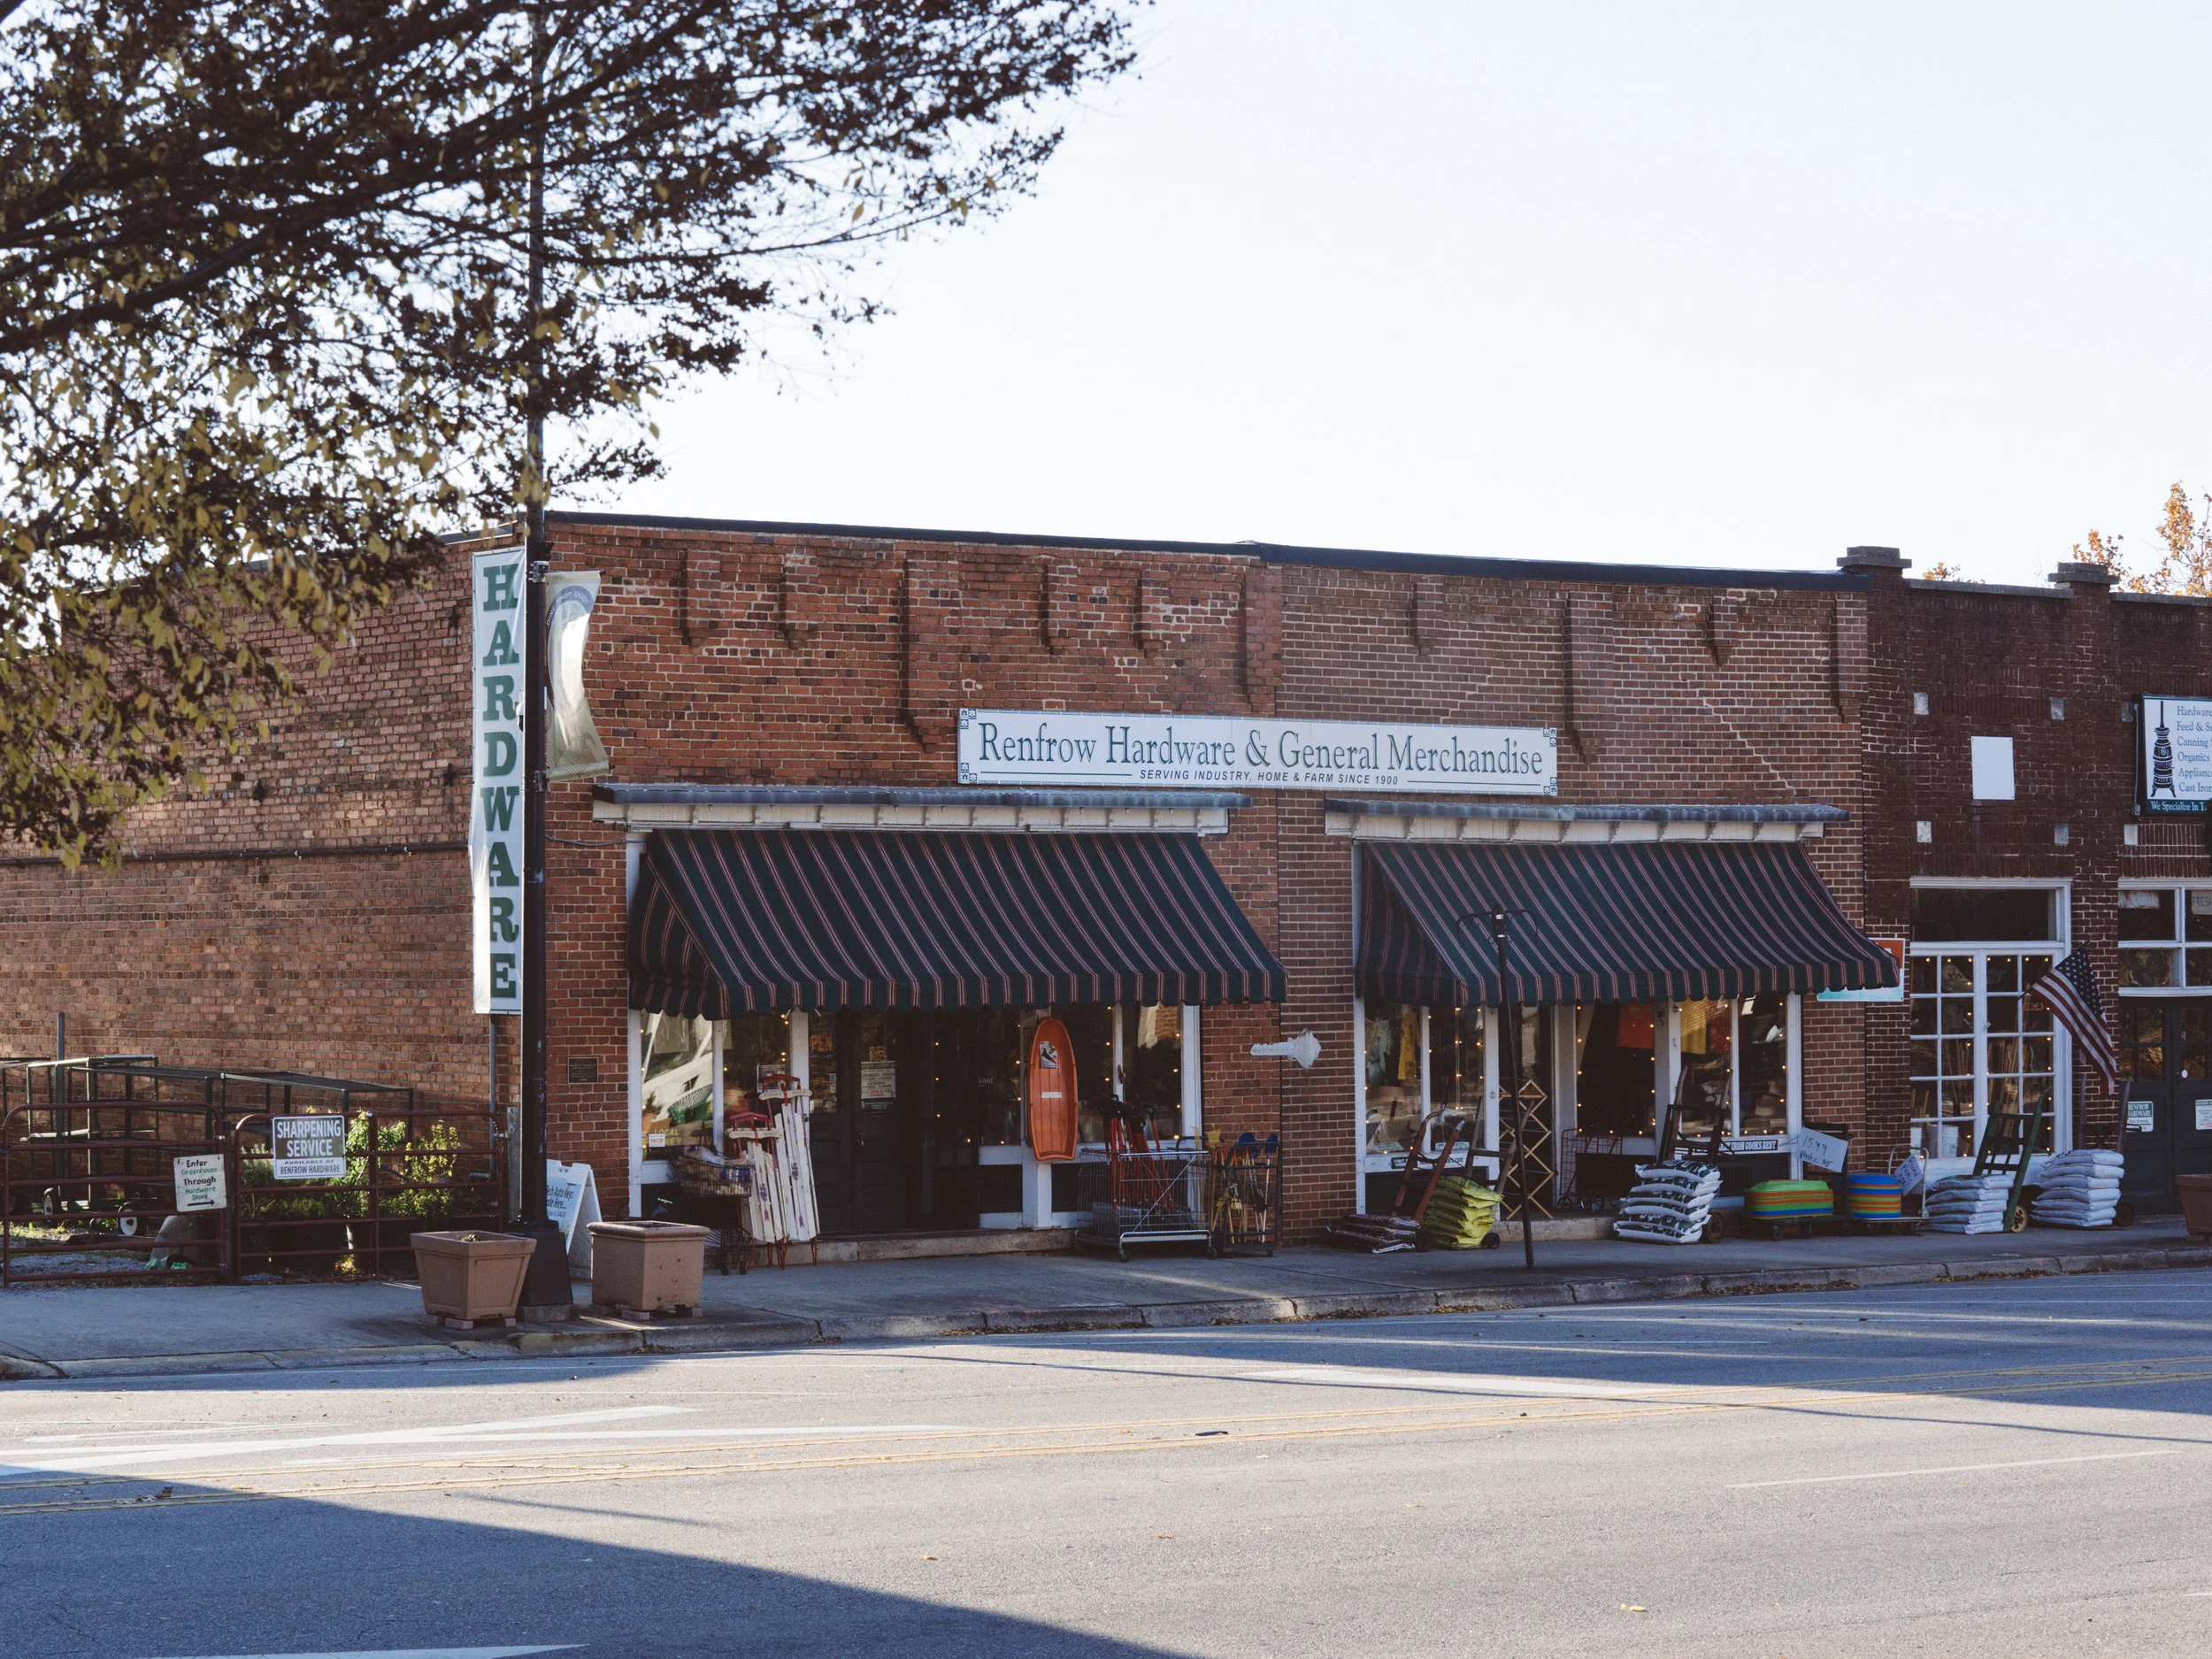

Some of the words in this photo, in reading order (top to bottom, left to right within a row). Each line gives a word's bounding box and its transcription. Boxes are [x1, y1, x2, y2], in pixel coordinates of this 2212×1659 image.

[2177, 720, 2193, 731] Feed
[2195, 721, 2203, 732] &
[978, 722, 1096, 763] Renfrow
[1105, 726, 1235, 765] Hardware
[1245, 729, 1271, 767] &
[1279, 731, 1379, 770] General
[1387, 734, 1542, 774] Merchandise
[2177, 735, 2208, 749] Canning
[2177, 750, 2210, 764] Organics
[1140, 769, 1189, 780] SERVING
[1194, 770, 1252, 782] INDUSTRY,
[1257, 772, 1288, 782] HOME
[1293, 772, 1300, 783] &
[1304, 772, 1333, 783] FARM
[1338, 773, 1370, 785] SINCE
[1375, 775, 1399, 786] 1900
[2178, 767, 2212, 779] Applianc
[480, 563, 519, 999] HARDWARE
[2178, 781, 2195, 792] Cast
[2150, 801, 2161, 810] We
[2162, 801, 2191, 812] Specialize
[2192, 802, 2199, 811] In
[276, 1119, 342, 1139] SHARPENING
[286, 1139, 333, 1157] SERVICE
[186, 1159, 208, 1168] Enter
[280, 1165, 307, 1175] RENFROW
[308, 1164, 341, 1173] HARDWARE
[180, 1167, 218, 1176] Greenhouse
[183, 1176, 217, 1187] Through
[554, 1186, 565, 1197] Auto
[564, 1187, 574, 1201] Keys
